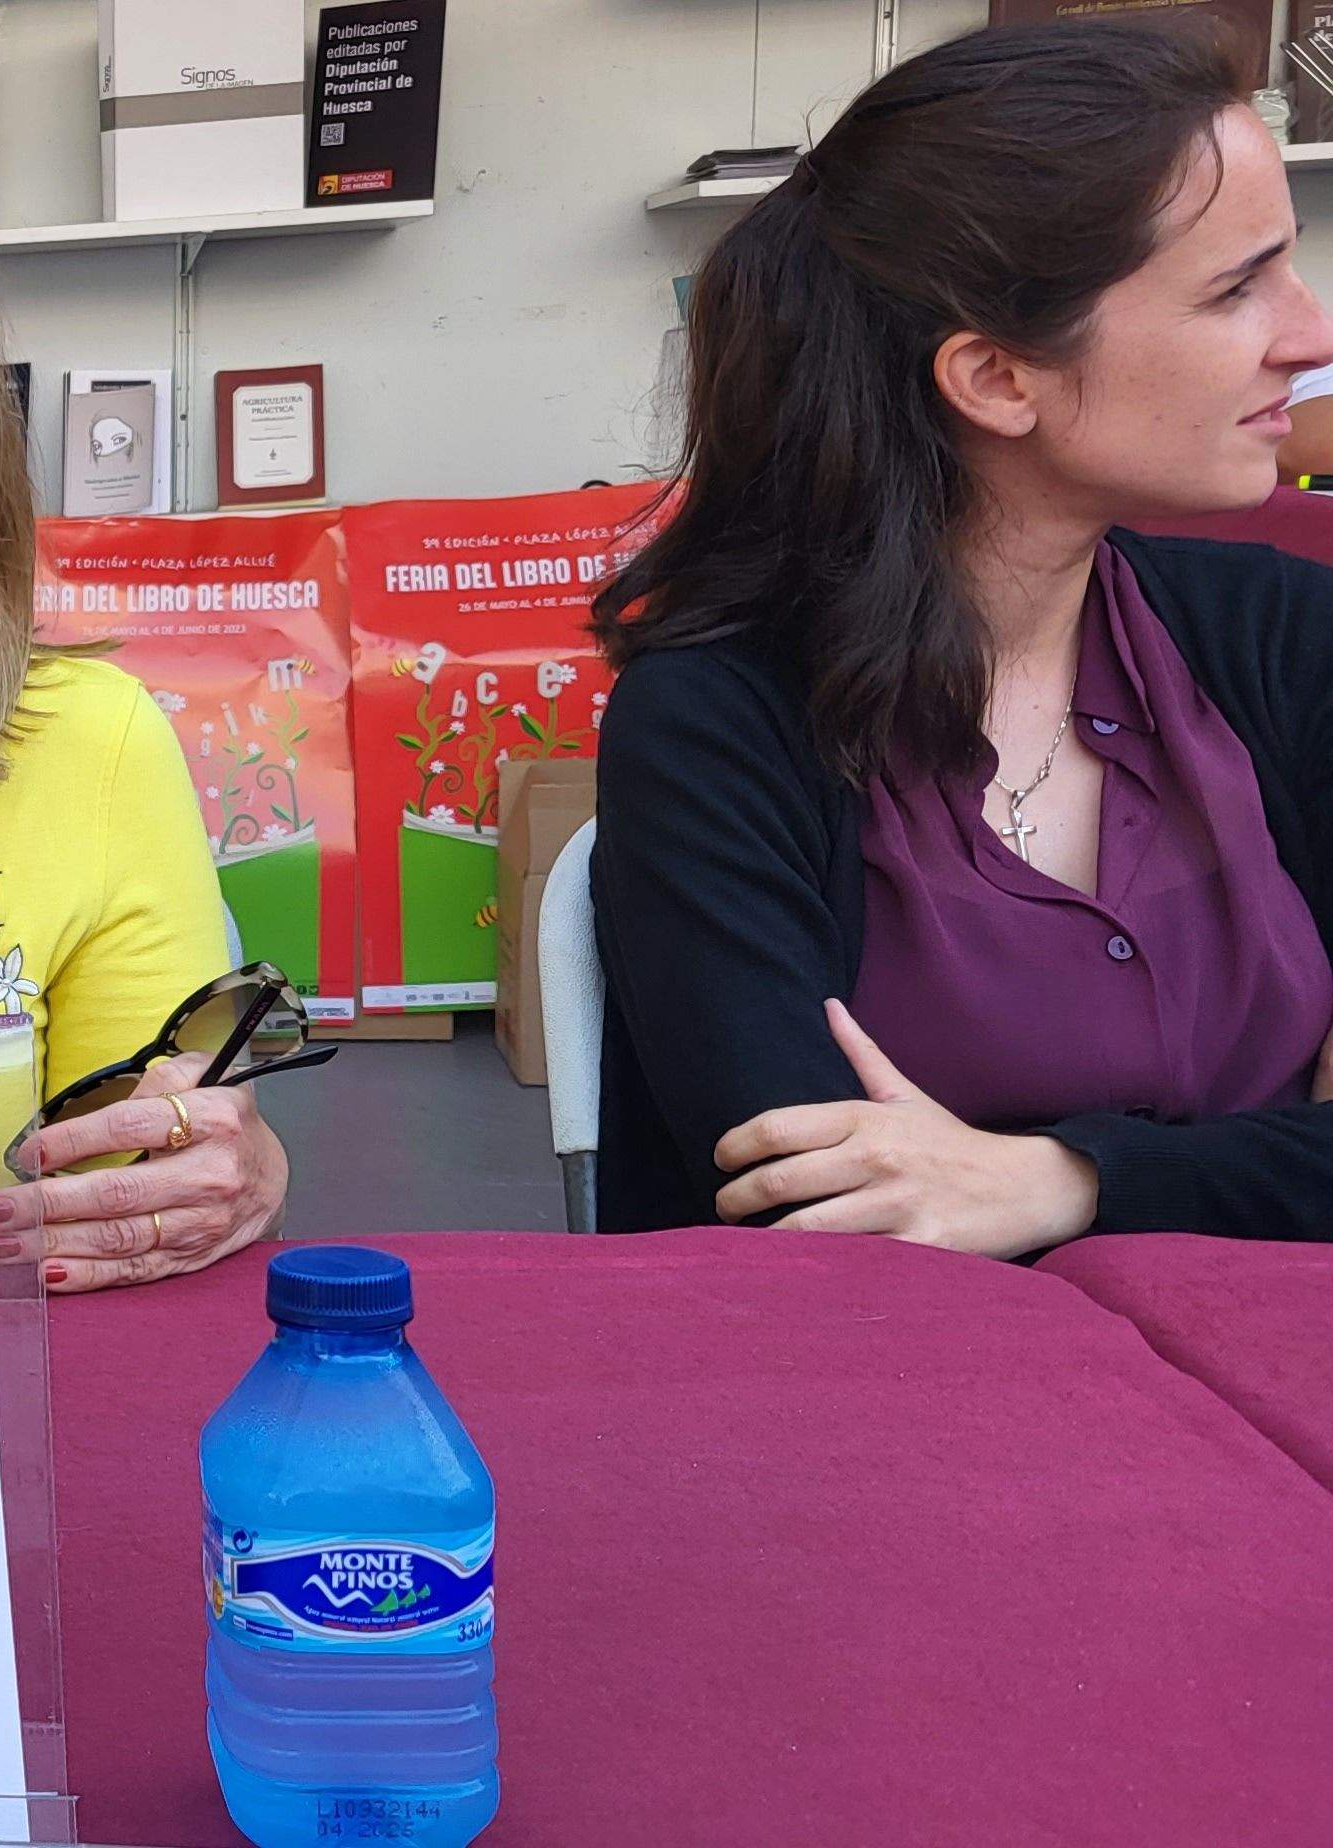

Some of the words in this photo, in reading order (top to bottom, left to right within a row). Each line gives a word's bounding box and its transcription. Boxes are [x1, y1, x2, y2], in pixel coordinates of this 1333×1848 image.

[328, 19, 418, 40] Publicaciones
[327, 41, 381, 59] editadas
[384, 39, 407, 57] por
[180, 67, 235, 88] Signos
[325, 57, 399, 78] Diputación
[324, 78, 393, 96] Provincial
[395, 74, 413, 89] de
[323, 99, 372, 116] Huesca
[353, 181, 385, 190] HUESCA
[243, 395, 303, 406] AGRICULTURA
[444, 534, 500, 549] EDICIÓN
[514, 532, 560, 545] PLAZA
[566, 527, 608, 542] LÓPEZ
[75, 555, 128, 569] EDICIÓN
[142, 556, 184, 570] PLAZA
[189, 555, 230, 569] LÓPEZ
[234, 553, 276, 568] ALLUÉ
[386, 564, 450, 592] FERIA
[455, 562, 497, 590] DEL
[502, 557, 571, 587] LIBRO
[577, 554, 607, 583] DE
[83, 585, 118, 612] DEL
[127, 585, 189, 612] LIBRO
[196, 585, 224, 611] DE
[231, 581, 319, 611] HUESCA
[458, 602, 470, 612] 26
[473, 601, 487, 611] DE
[490, 600, 517, 610] MAYO
[519, 600, 532, 609] AL
[534, 599, 541, 607] 4
[543, 598, 557, 607] DE
[110, 626, 136, 636] MAYO
[139, 626, 150, 635] AL
[152, 626, 159, 634] 4
[161, 626, 174, 634] DE
[177, 625, 205, 635] JUNIO
[208, 625, 220, 634] DE
[319, 1552, 414, 1572] MONTE
[332, 1571, 414, 1590] PINOS
[303, 1605, 320, 1617] Agua
[457, 1618, 483, 1643] 330
